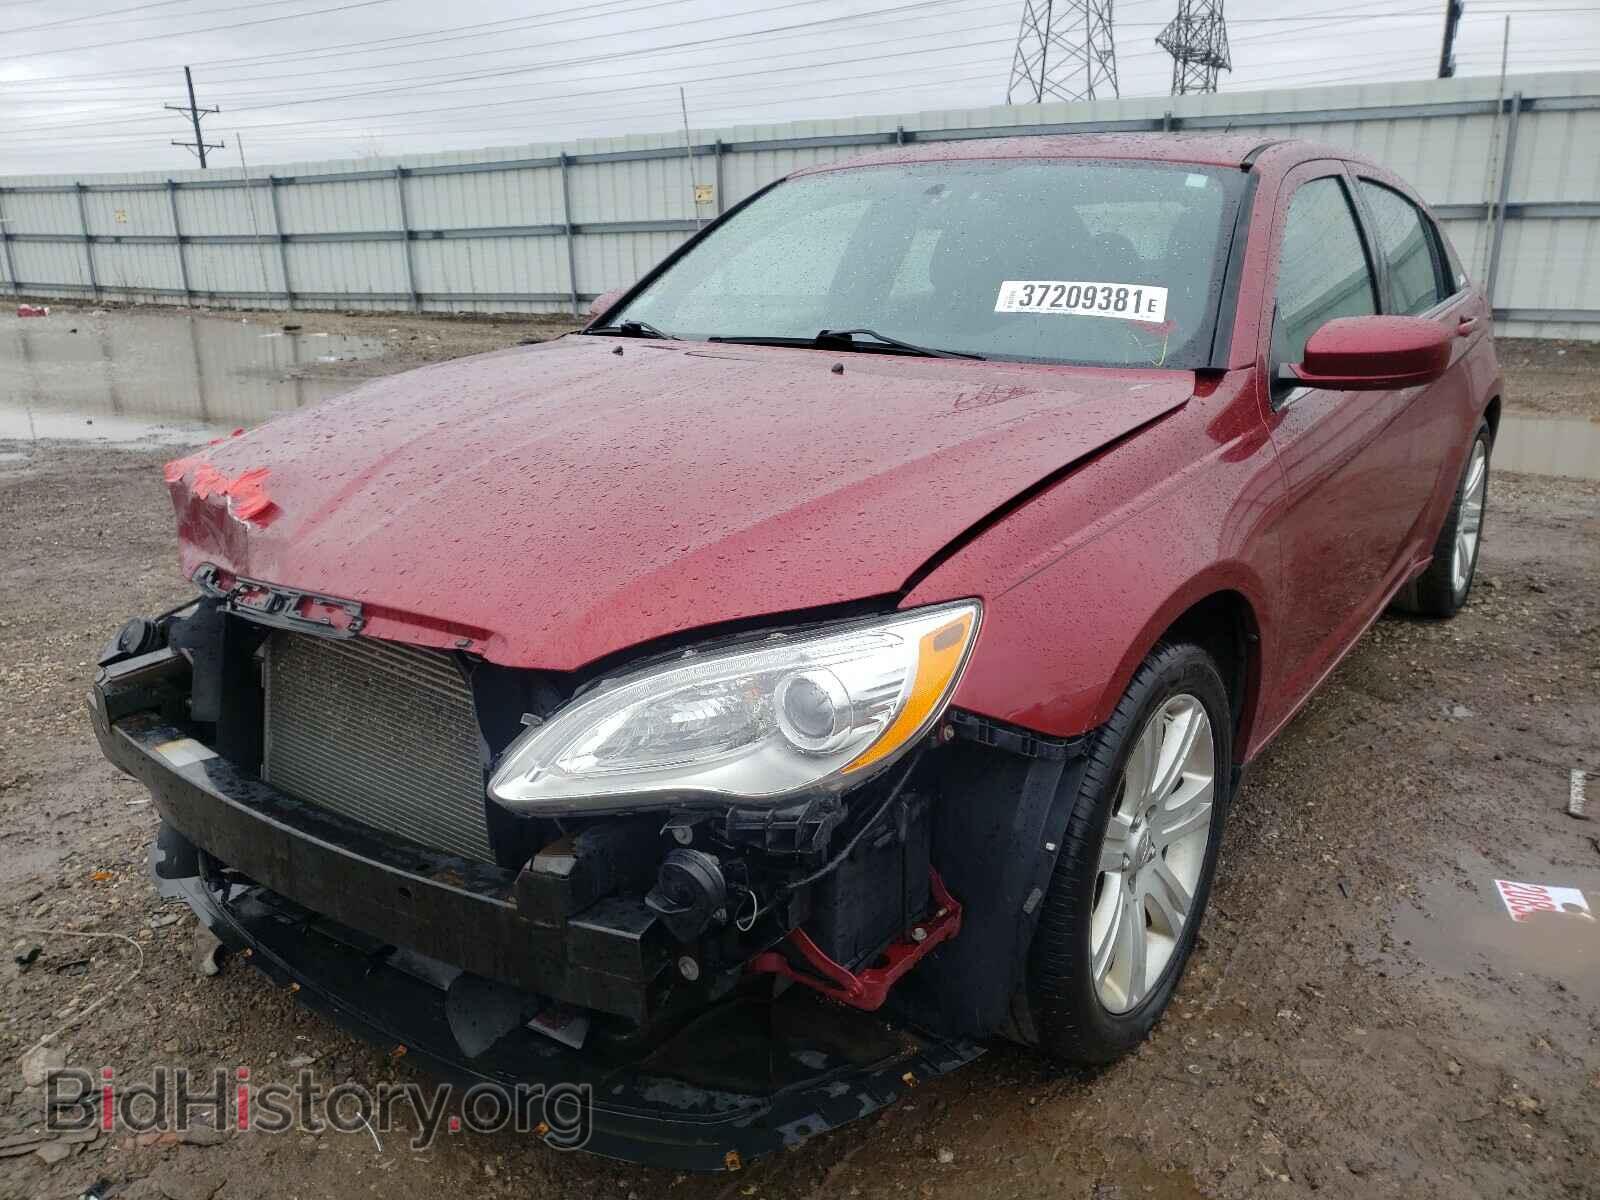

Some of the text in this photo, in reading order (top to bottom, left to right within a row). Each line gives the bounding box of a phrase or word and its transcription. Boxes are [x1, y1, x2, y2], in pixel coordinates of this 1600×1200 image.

[1019, 284, 1143, 313] 37209381
[1148, 299, 1158, 312] E
[1500, 881, 1556, 920] 208
